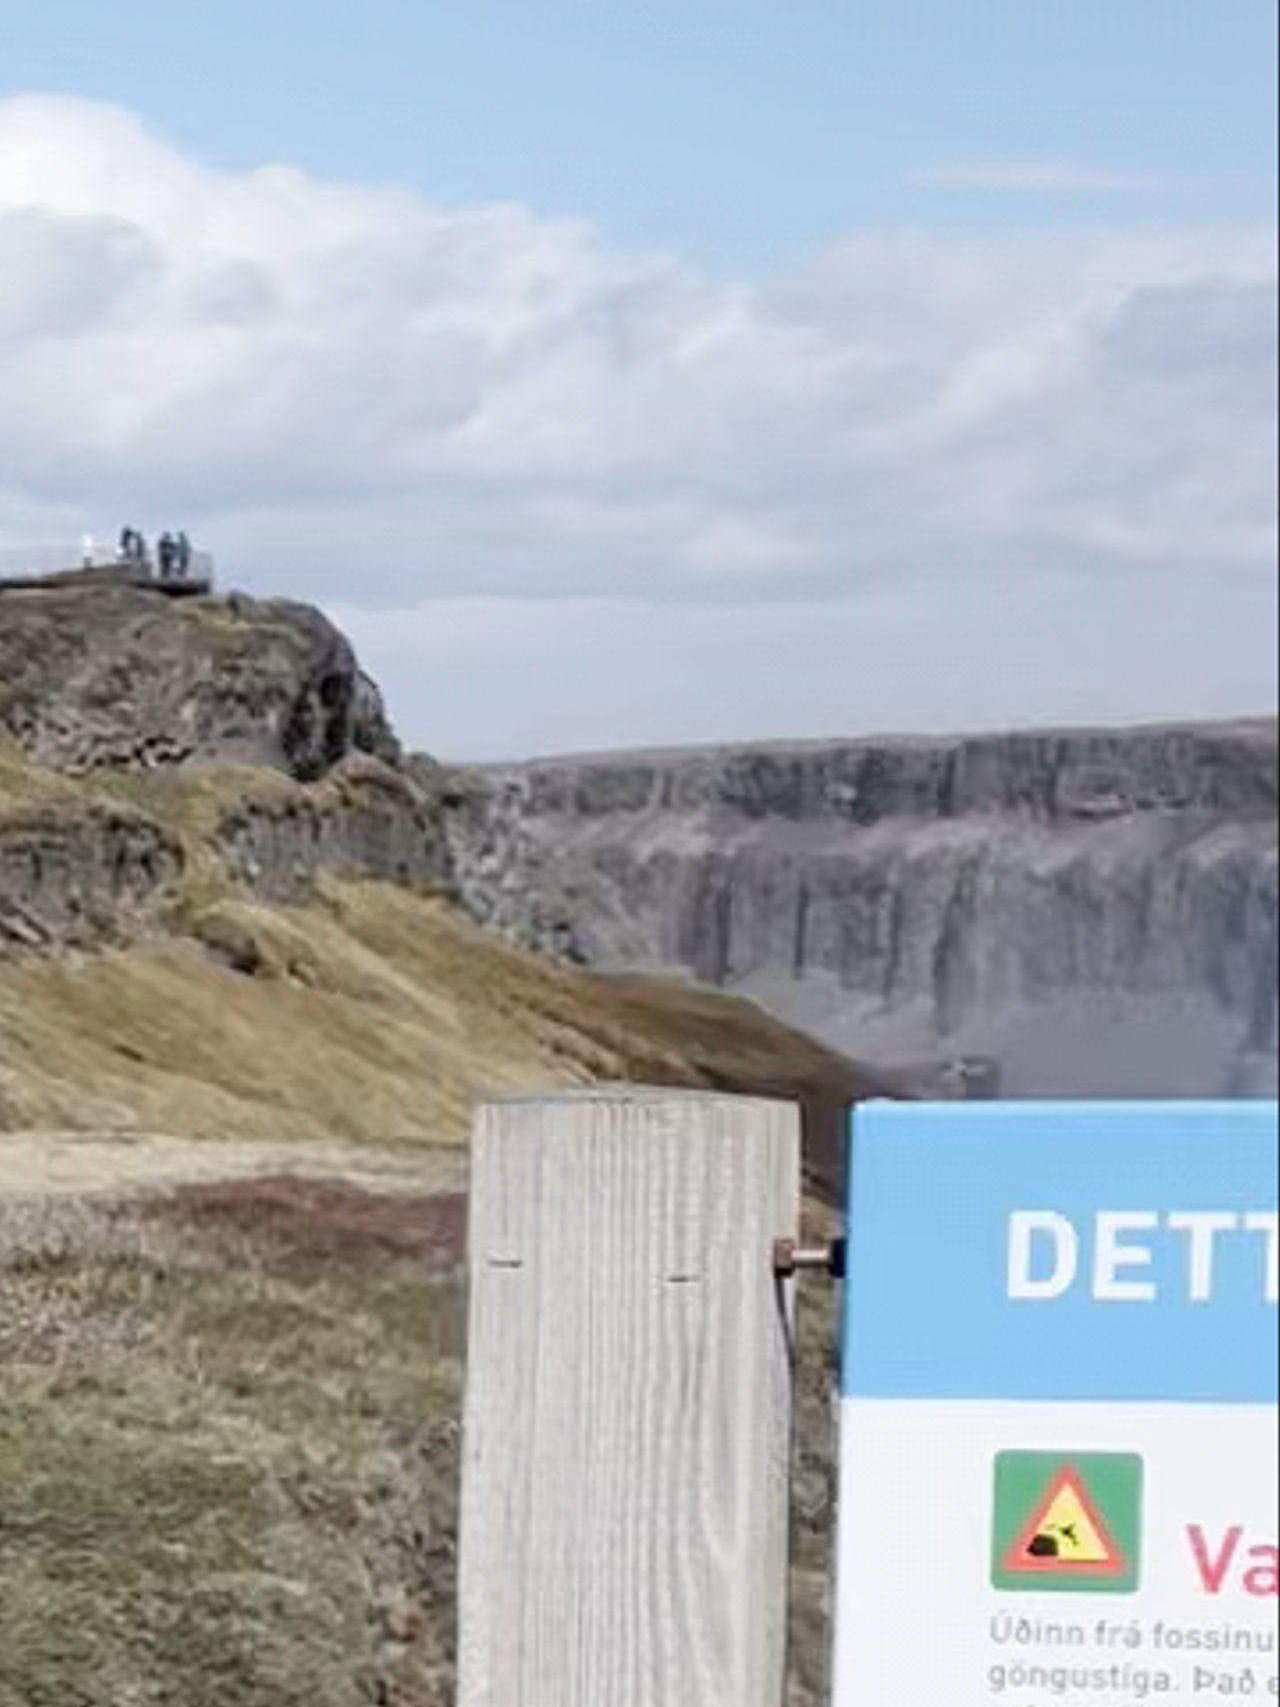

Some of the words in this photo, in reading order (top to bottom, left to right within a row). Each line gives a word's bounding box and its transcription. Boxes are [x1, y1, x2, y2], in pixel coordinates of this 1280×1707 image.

[1184, 1524, 1278, 1597] Va
[988, 1609, 1084, 1646] Úðinn
[1095, 1619, 1141, 1647] frá
[1153, 1623, 1274, 1652] fossinu
[987, 1660, 1180, 1698] göngustíga.
[1193, 1666, 1255, 1695] Það
